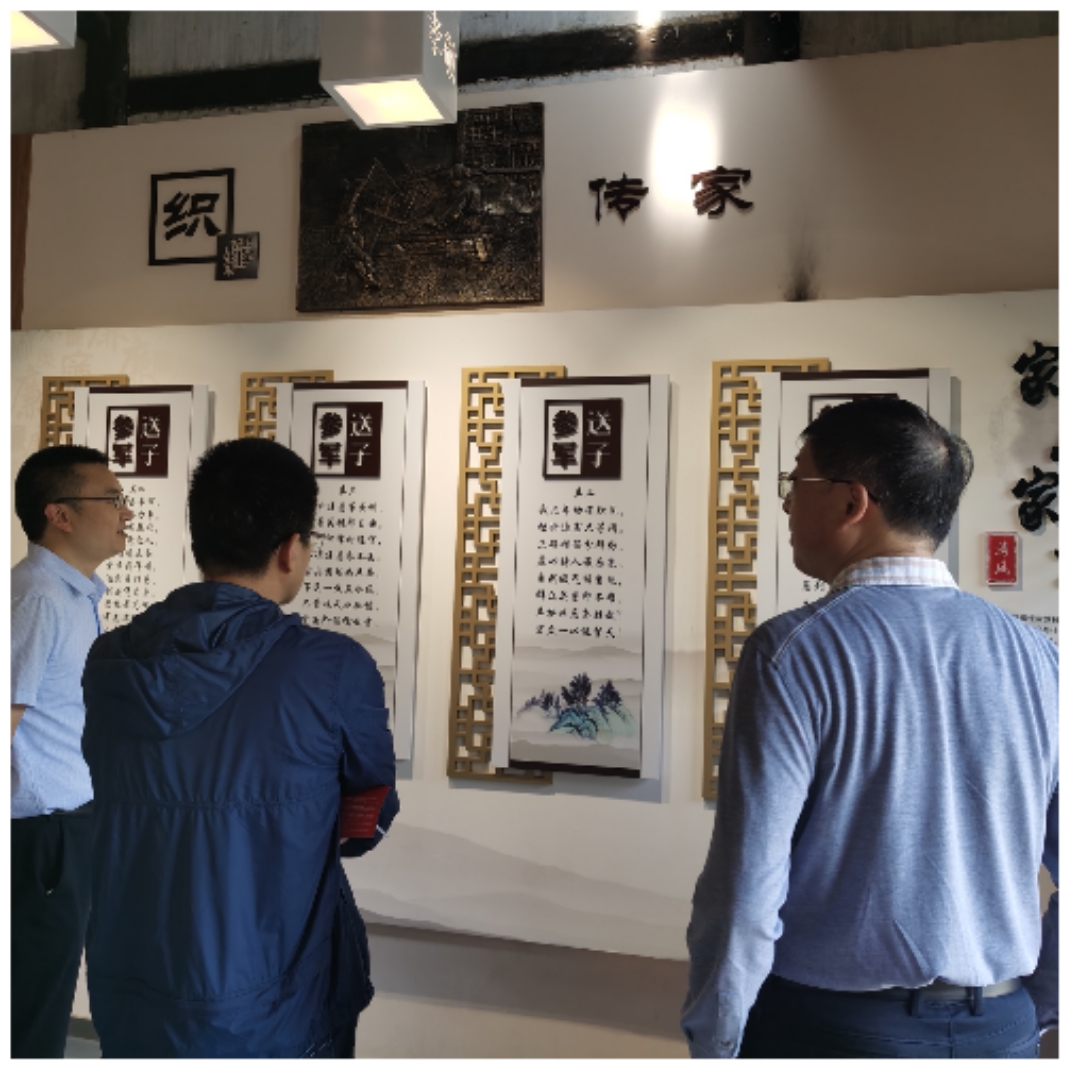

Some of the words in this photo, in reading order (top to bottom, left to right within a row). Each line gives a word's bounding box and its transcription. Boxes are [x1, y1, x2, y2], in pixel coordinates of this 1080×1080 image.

[163, 190, 222, 241] 织
[140, 414, 161, 467] 送子
[349, 412, 373, 467] 送子
[586, 410, 612, 469] 送子
